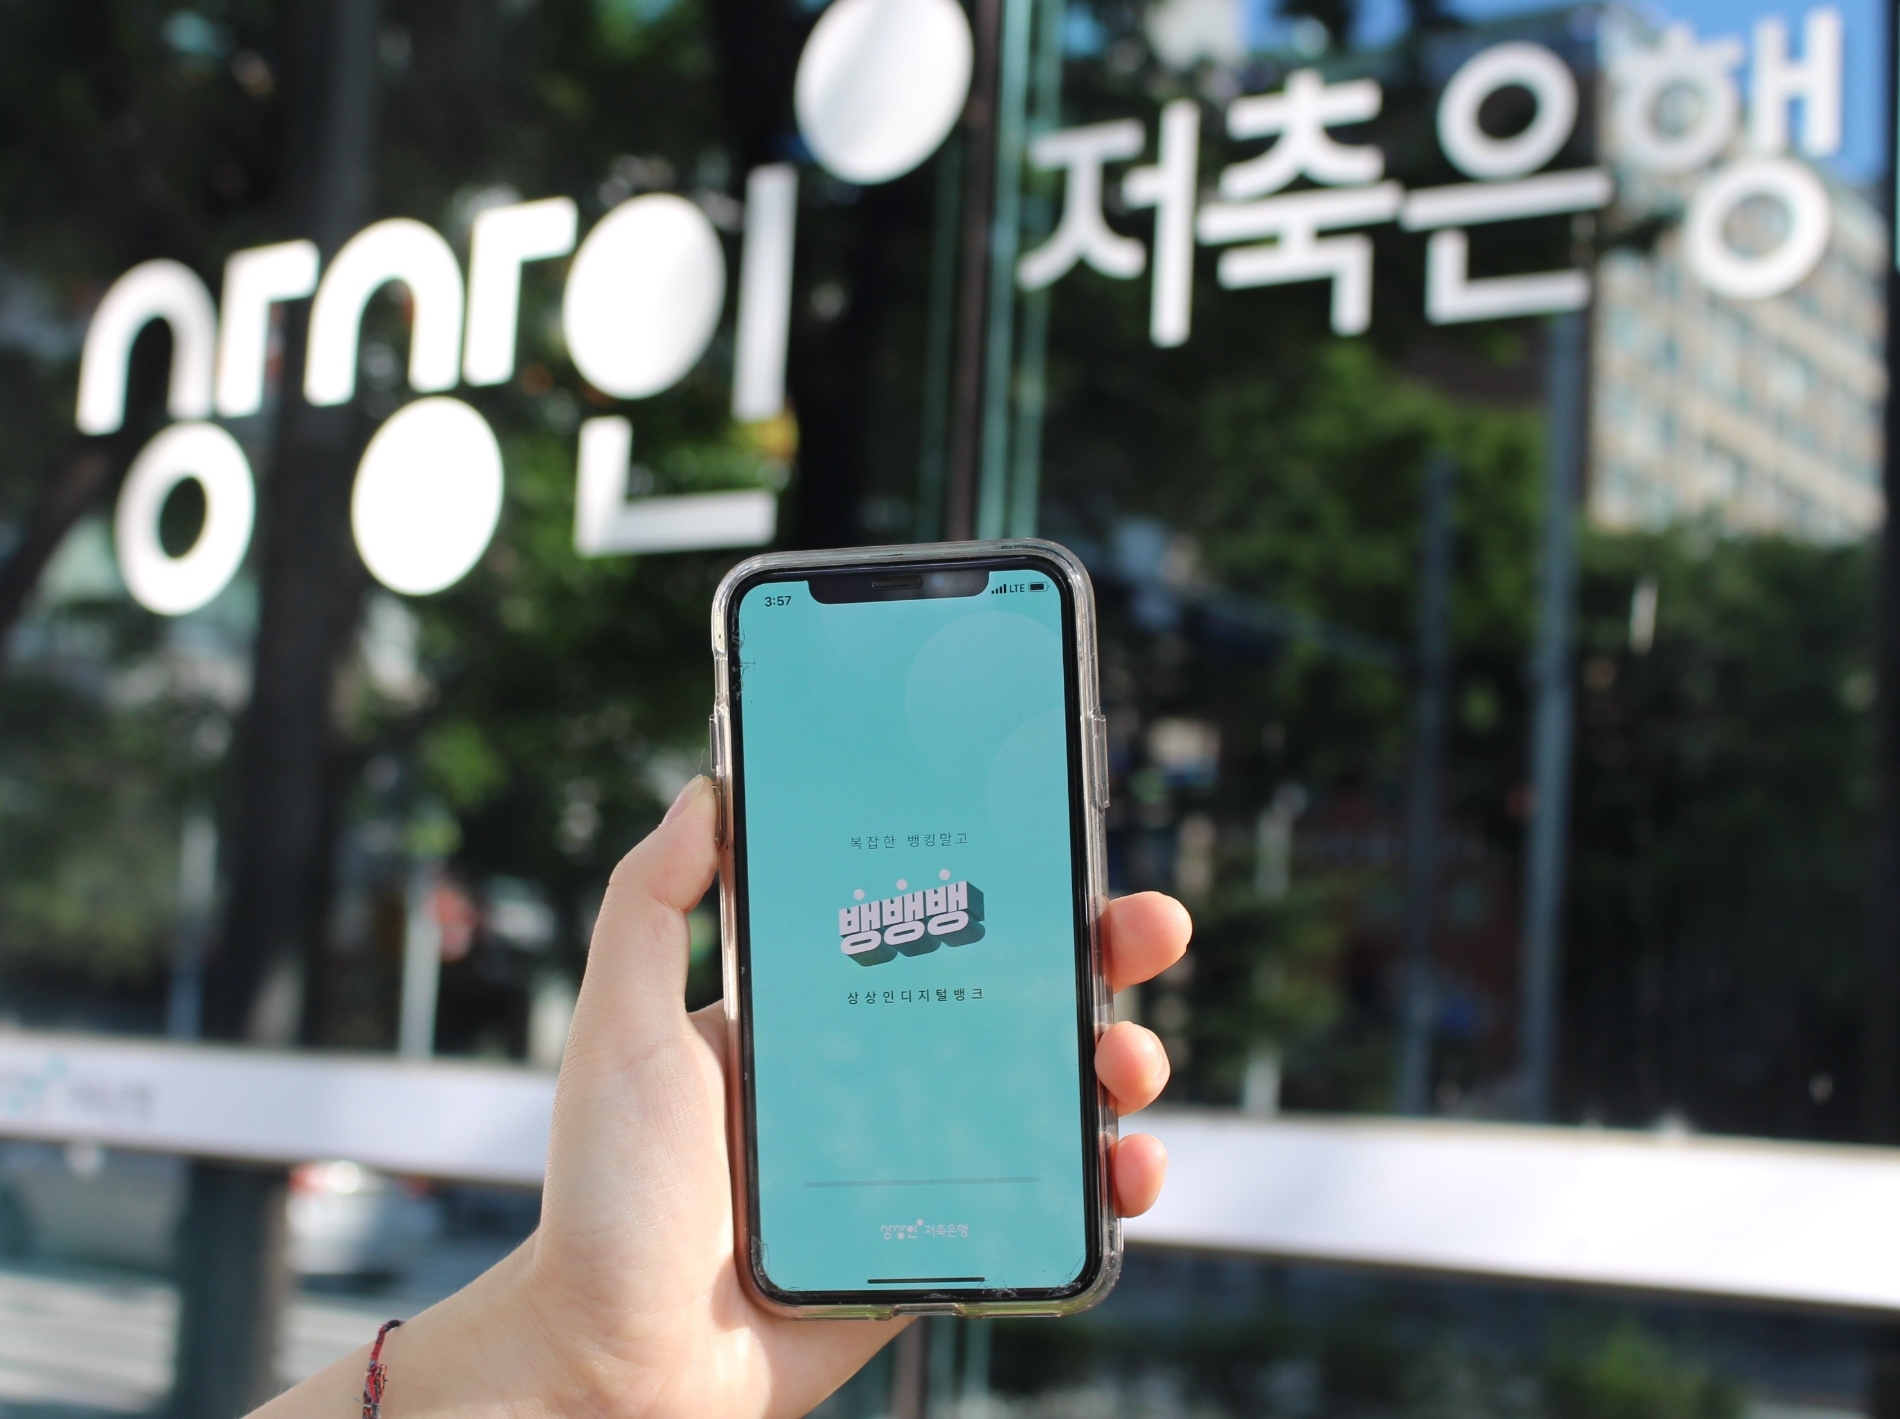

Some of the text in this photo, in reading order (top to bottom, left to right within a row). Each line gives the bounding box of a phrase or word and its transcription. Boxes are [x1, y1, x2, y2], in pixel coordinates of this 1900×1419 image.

[76, 9, 1842, 616] 상상인 저축은행
[1009, 582, 1025, 593] LTE
[764, 595, 792, 608] 3:57
[851, 832, 968, 850] 복잡한 뱅킹말고
[839, 880, 970, 955] 뱅뱅뱅
[847, 988, 984, 1005] 상상인디지털뱅크
[880, 1223, 969, 1240] 상상인 저축은행
